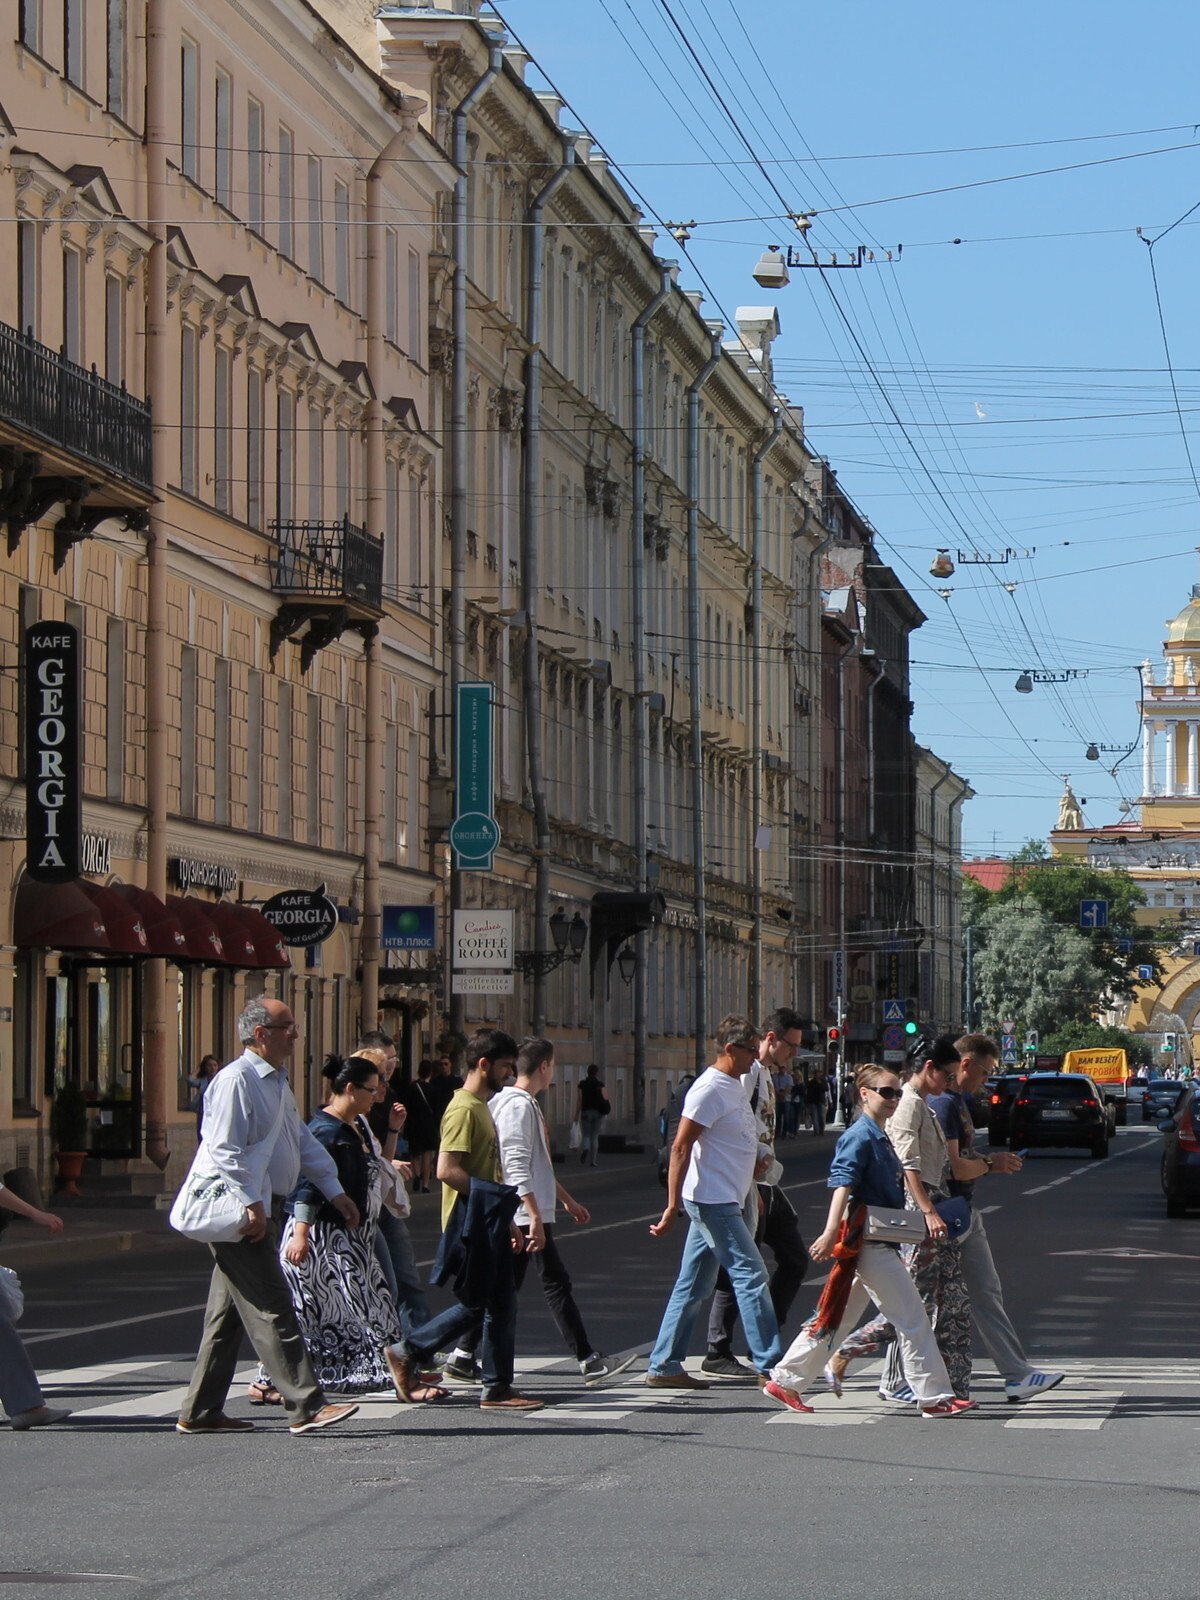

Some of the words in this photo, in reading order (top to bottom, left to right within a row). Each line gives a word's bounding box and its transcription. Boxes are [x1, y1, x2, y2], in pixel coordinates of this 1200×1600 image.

[32, 636, 71, 648] KAFE
[37, 658, 66, 867] GEORGIA
[454, 831, 493, 840] ОВСЯНКА
[82, 834, 111, 874] ORGIA
[179, 858, 219, 888] грузинская
[218, 867, 238, 890] кухня
[281, 896, 311, 906] KAFE
[264, 909, 331, 924] GEORGIA
[301, 924, 328, 941] Georgia
[458, 937, 508, 948] COFFEE
[458, 949, 508, 959] ROOM
[1076, 1066, 1121, 1076] ПЕТРОВИЧ
